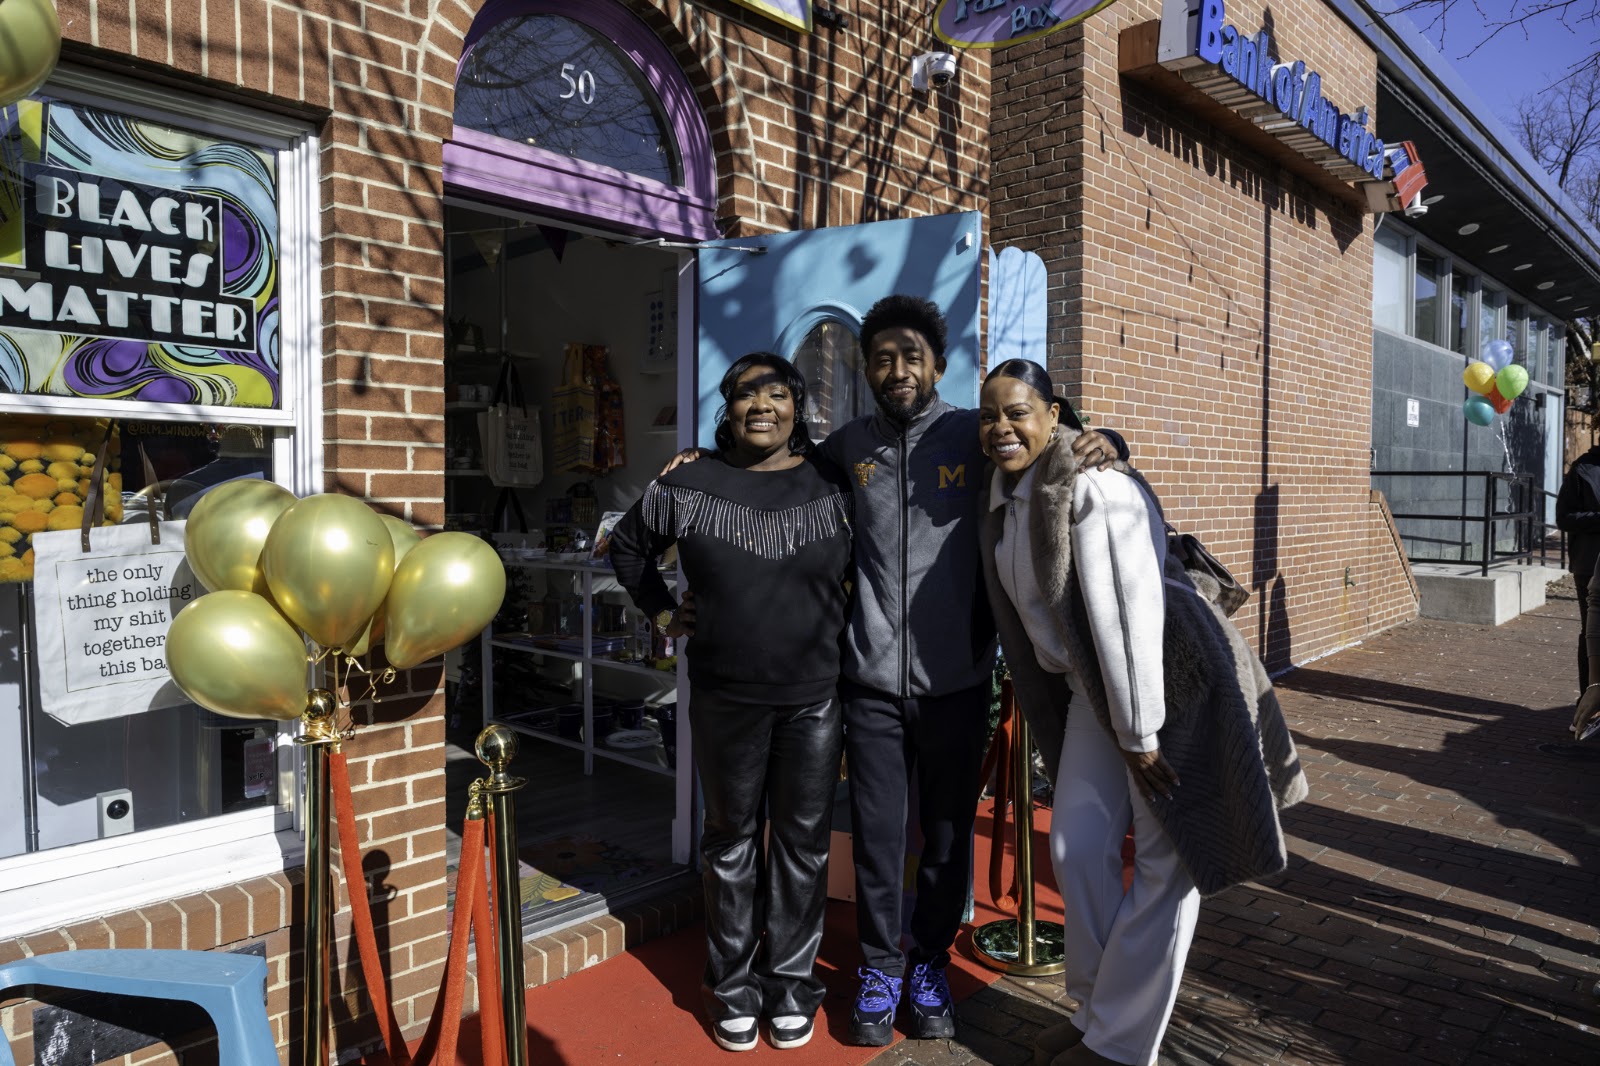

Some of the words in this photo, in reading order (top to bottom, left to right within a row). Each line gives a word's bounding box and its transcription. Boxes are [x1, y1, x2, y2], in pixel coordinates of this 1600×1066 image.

[559, 62, 596, 105] 50
[1198, 0, 1276, 105] Bank
[1273, 60, 1306, 121] of
[1301, 71, 1385, 181] America
[35, 174, 214, 242] BLACK
[44, 230, 214, 288] LIVES
[0, 278, 247, 342] MATTER
[937, 463, 967, 489] M
[86, 568, 118, 584] the
[122, 564, 164, 581] only
[67, 591, 117, 611] thing
[121, 584, 191, 603] holding
[93, 616, 124, 632] my
[129, 609, 167, 627] shit
[83, 634, 166, 657] together
[99, 660, 136, 678] this
[140, 657, 169, 671] ba
